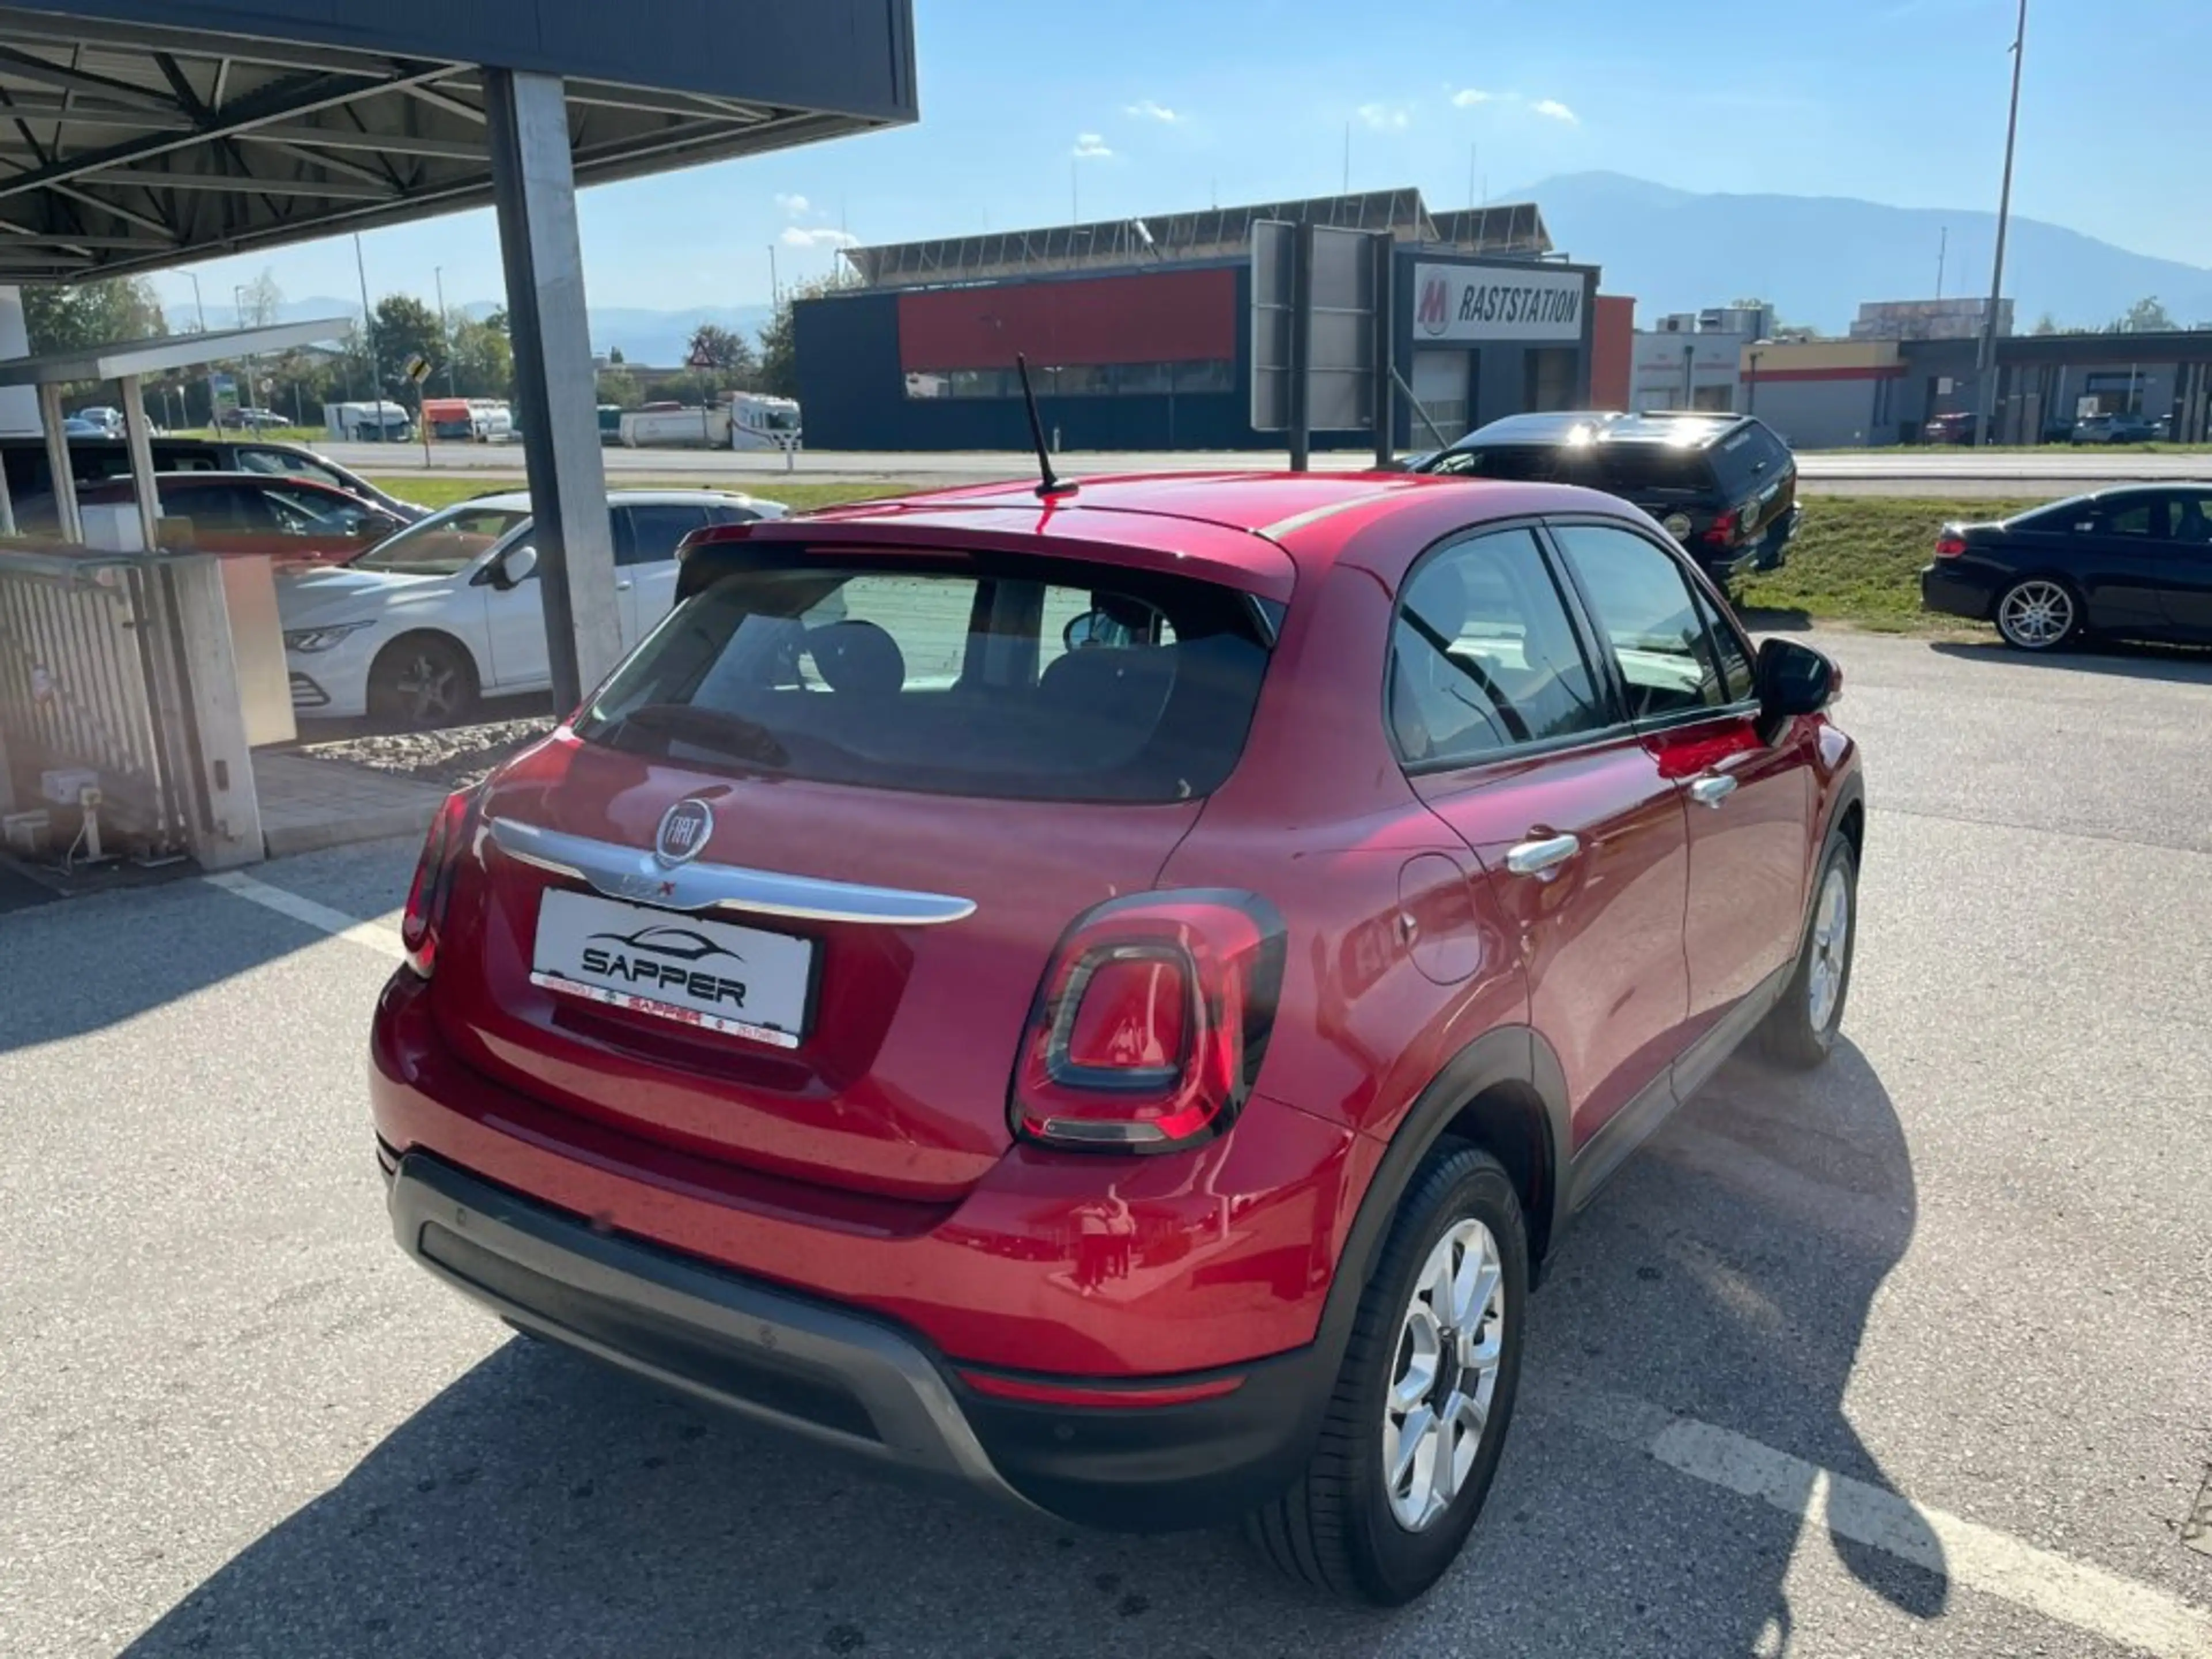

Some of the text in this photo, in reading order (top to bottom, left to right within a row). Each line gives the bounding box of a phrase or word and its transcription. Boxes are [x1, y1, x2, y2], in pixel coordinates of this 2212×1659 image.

[1457, 284, 1580, 324] RASTSTATION
[665, 816, 702, 847] FIAT
[581, 948, 747, 1009] SAPPER
